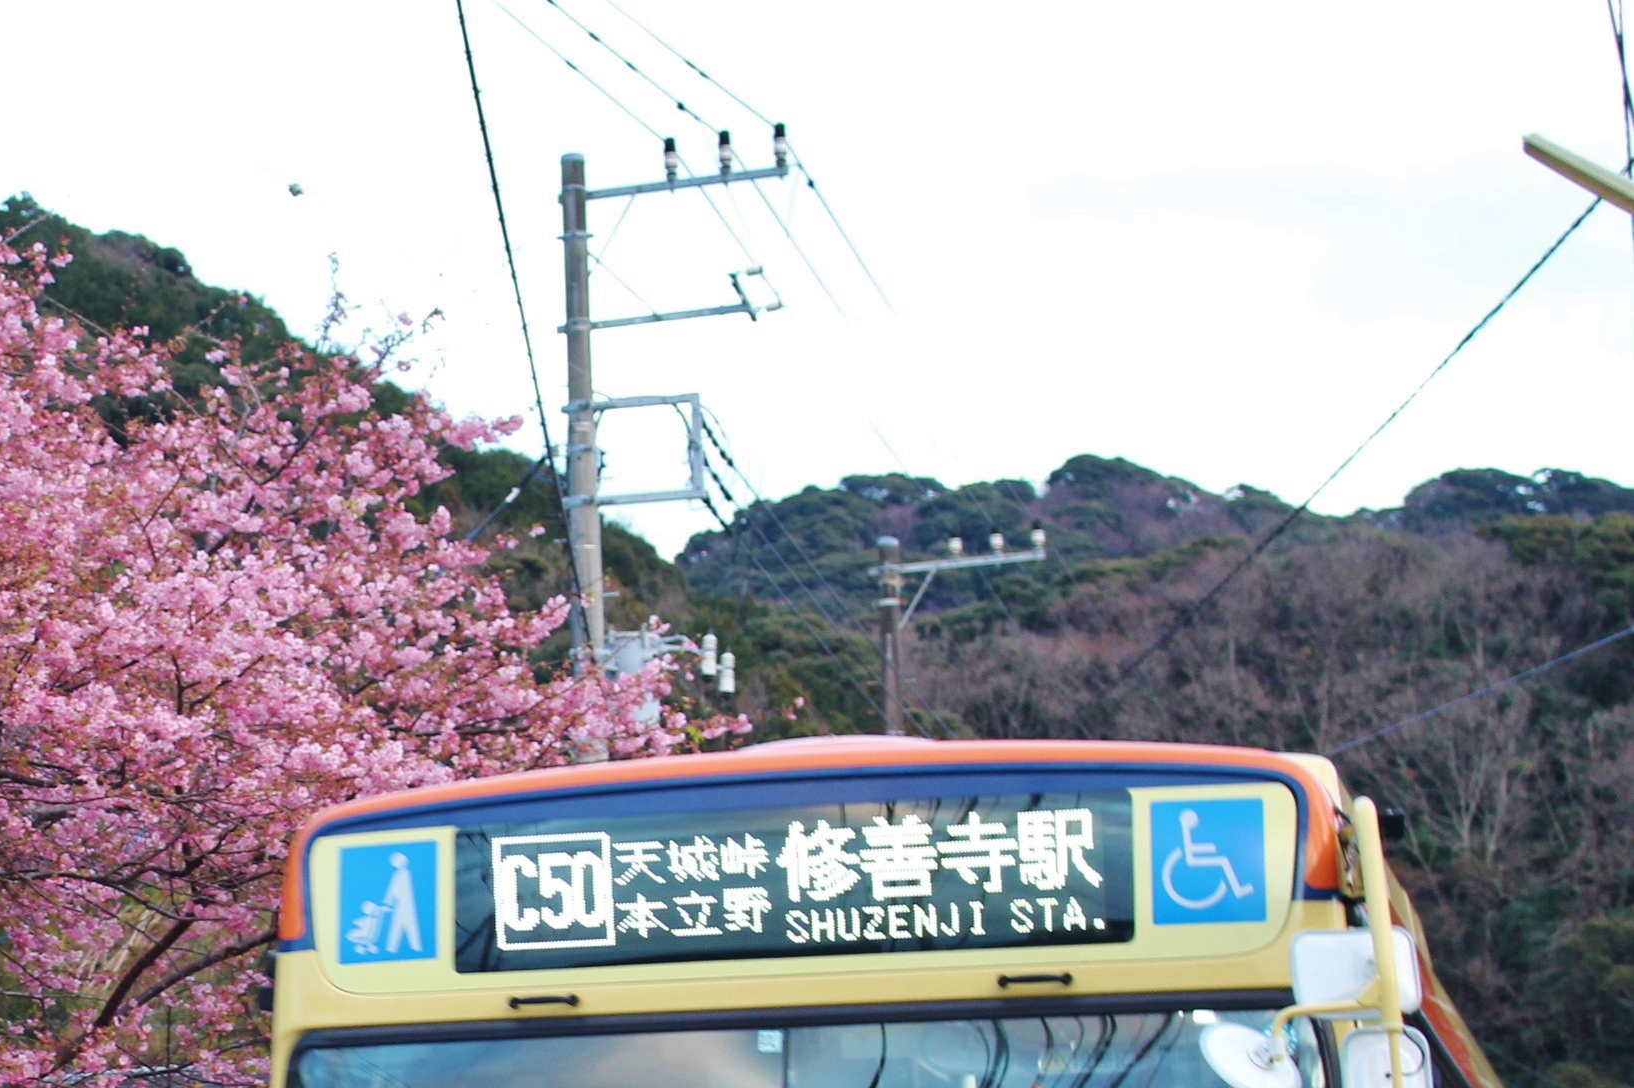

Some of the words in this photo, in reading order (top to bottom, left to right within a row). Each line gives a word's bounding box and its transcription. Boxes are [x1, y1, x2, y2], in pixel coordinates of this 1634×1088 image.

[613, 833, 769, 886] 天城峠
[776, 808, 1103, 902] 修善寺駅
[501, 851, 605, 931] C50
[615, 887, 771, 939] 本立野
[785, 901, 986, 943] SHUZENJI
[1010, 896, 1105, 934] STA.
